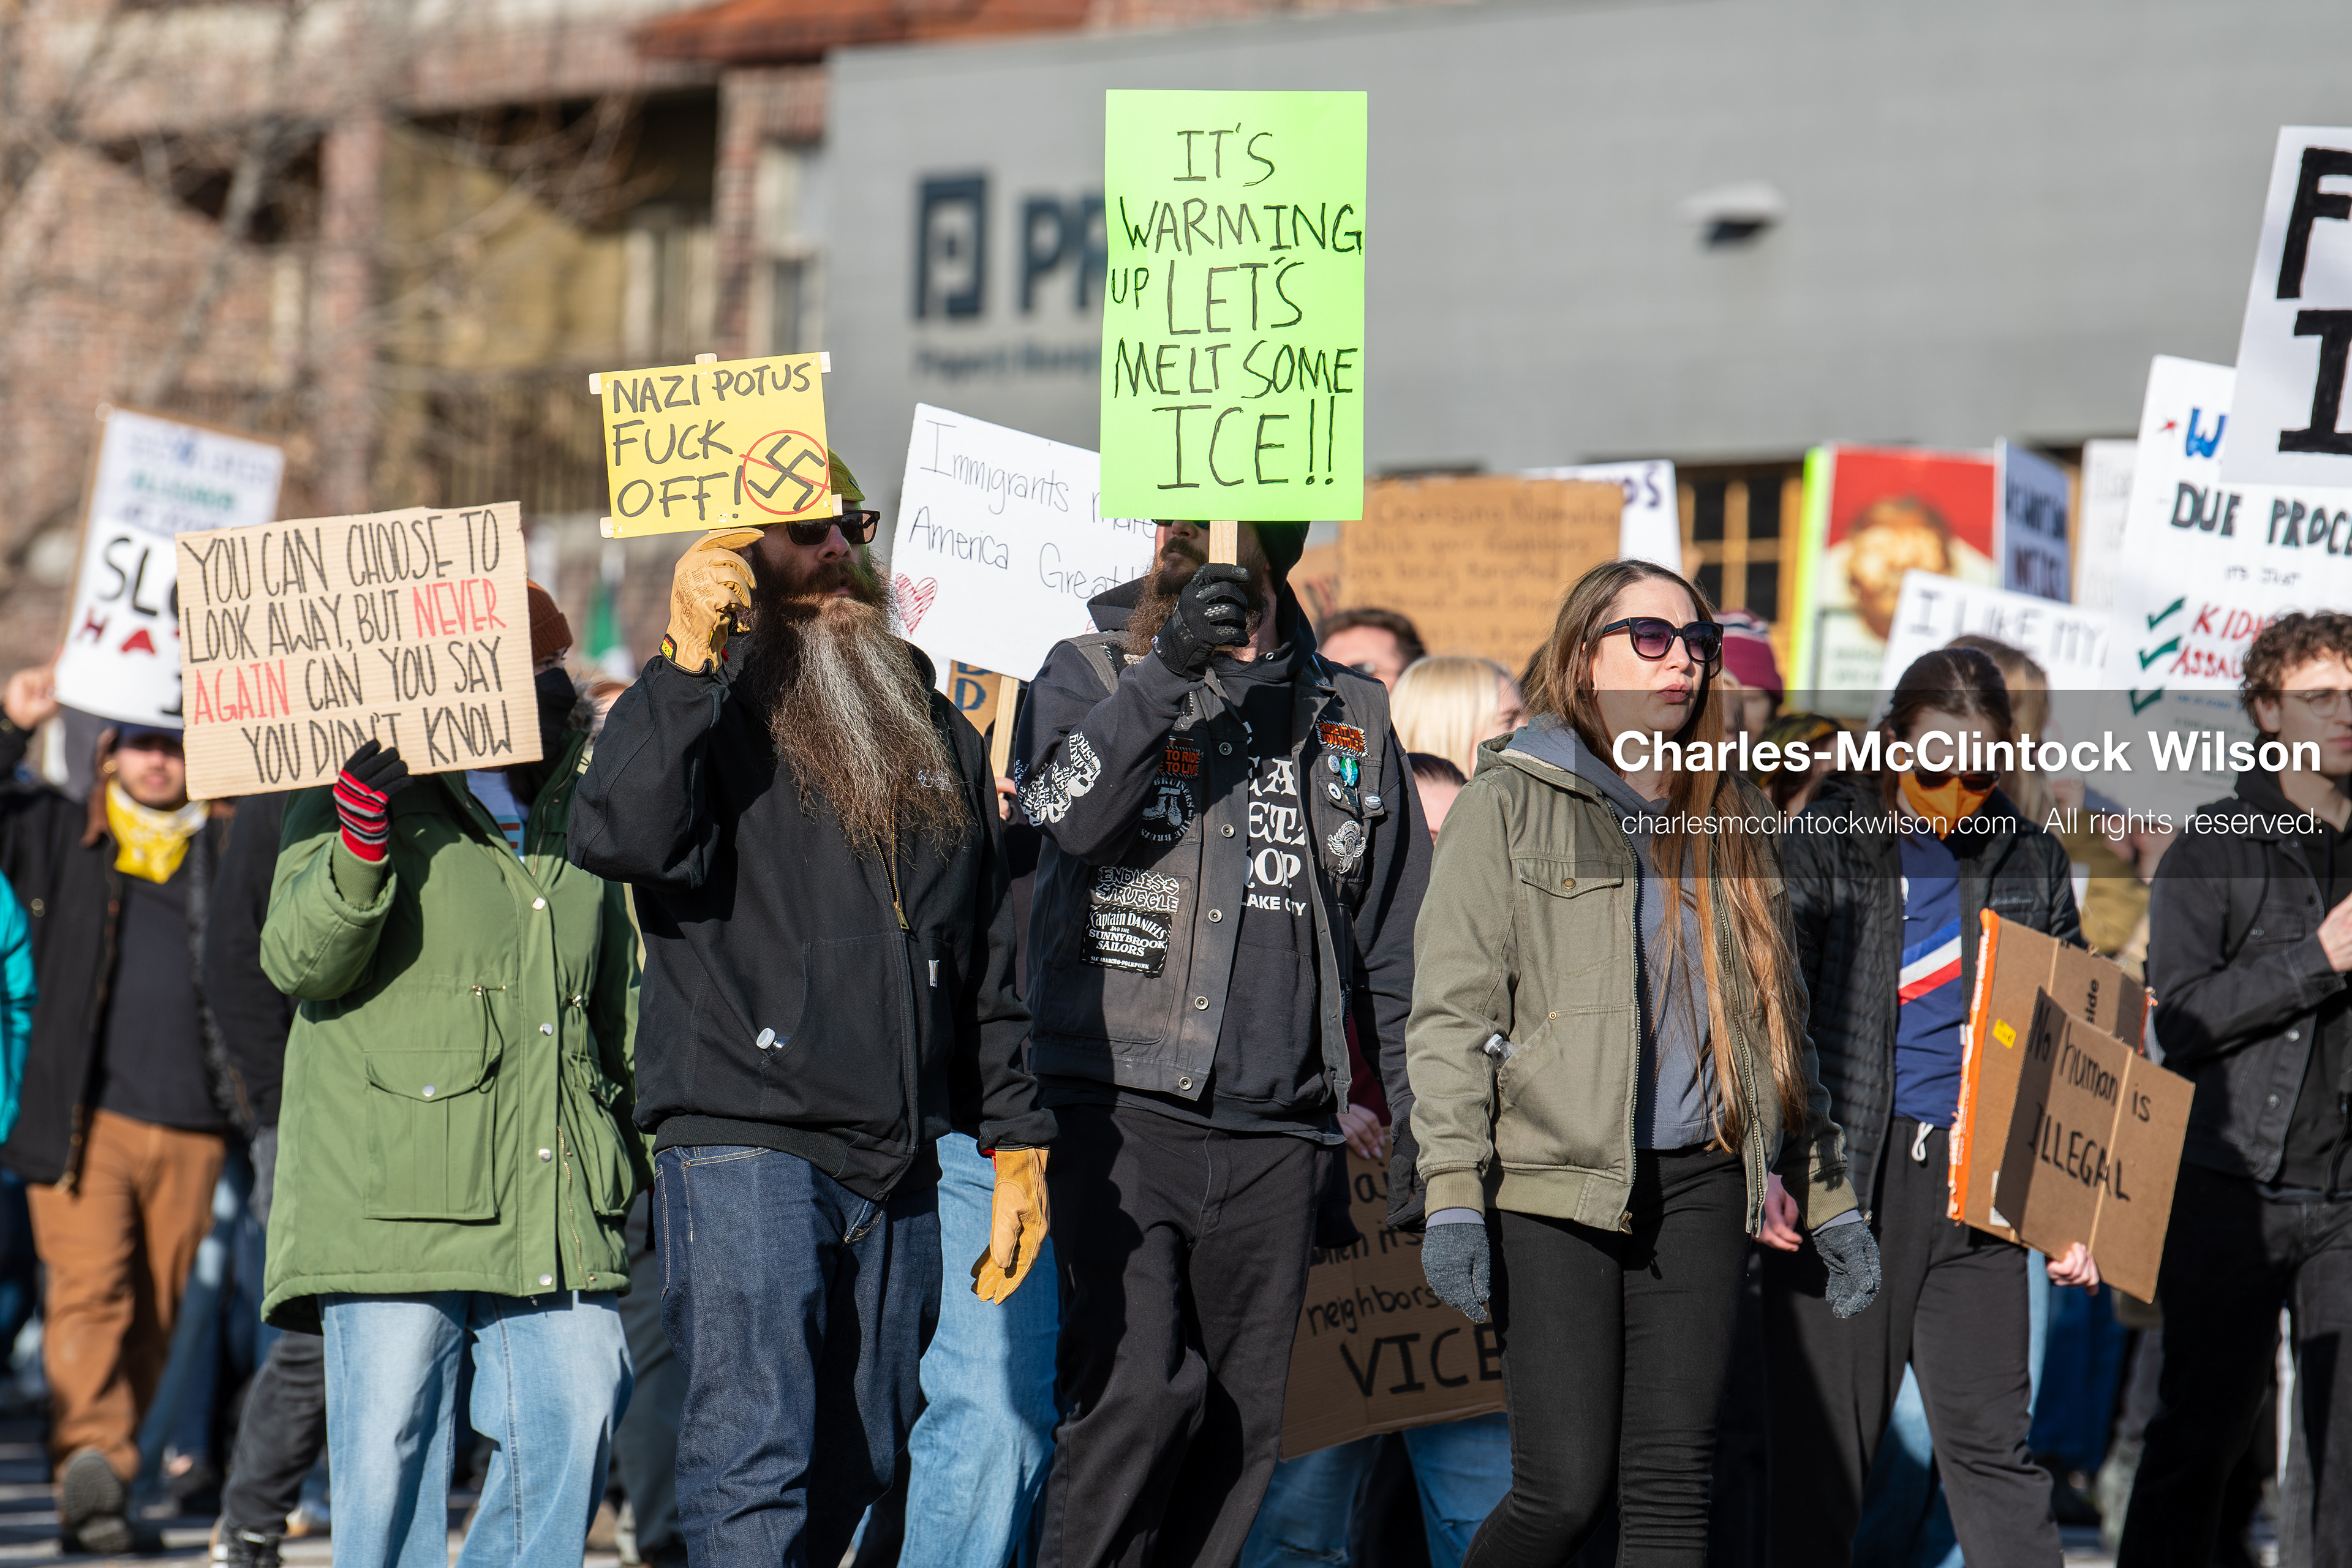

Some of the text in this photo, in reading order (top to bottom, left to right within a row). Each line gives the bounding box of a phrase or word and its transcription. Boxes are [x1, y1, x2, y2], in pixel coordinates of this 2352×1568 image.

[1174, 123, 1275, 186] IT'S
[1120, 196, 1362, 255] WARMING
[1112, 257, 1305, 335] UP LET'S
[613, 362, 811, 413] NAZI POTUS
[1115, 338, 1231, 398] MELT
[1241, 339, 1359, 399] SOME
[613, 420, 733, 466] FUCK
[921, 420, 1068, 514] Immigrants
[1152, 396, 1335, 490] ICE!!
[617, 466, 744, 520] OFF!
[2171, 481, 2242, 536] DUE
[183, 510, 500, 605] YOU CAN CHOOSE TO
[909, 507, 1008, 570] America
[97, 535, 179, 616] SL
[184, 578, 507, 663] LOOK AWAY, BUT NEVER
[194, 659, 290, 725] AGAIN
[306, 647, 363, 711] CAN
[379, 644, 437, 702] YOU
[449, 636, 503, 693] SAY
[242, 723, 301, 784] YOU
[423, 700, 512, 767] KNOW
[1166, 750, 1199, 764] TO RIDE
[1319, 722, 1340, 735] RIDE
[1339, 726, 1348, 736] IT
[1321, 733, 1338, 745] YOU
[1338, 735, 1359, 752] STOLE
[1166, 762, 1180, 774] TO
[1182, 765, 1197, 775] LIVE
[1096, 883, 1180, 913] STRUGGLE
[1098, 866, 1180, 895] ENDLESS
[1089, 929, 1166, 949] SUNNYBROOK
[1090, 910, 1167, 940] Captain DANIELS
[1096, 940, 1145, 957] SAILORS
[2027, 1000, 2151, 1123] No human is
[2027, 1101, 2131, 1204] ILLEGAL
